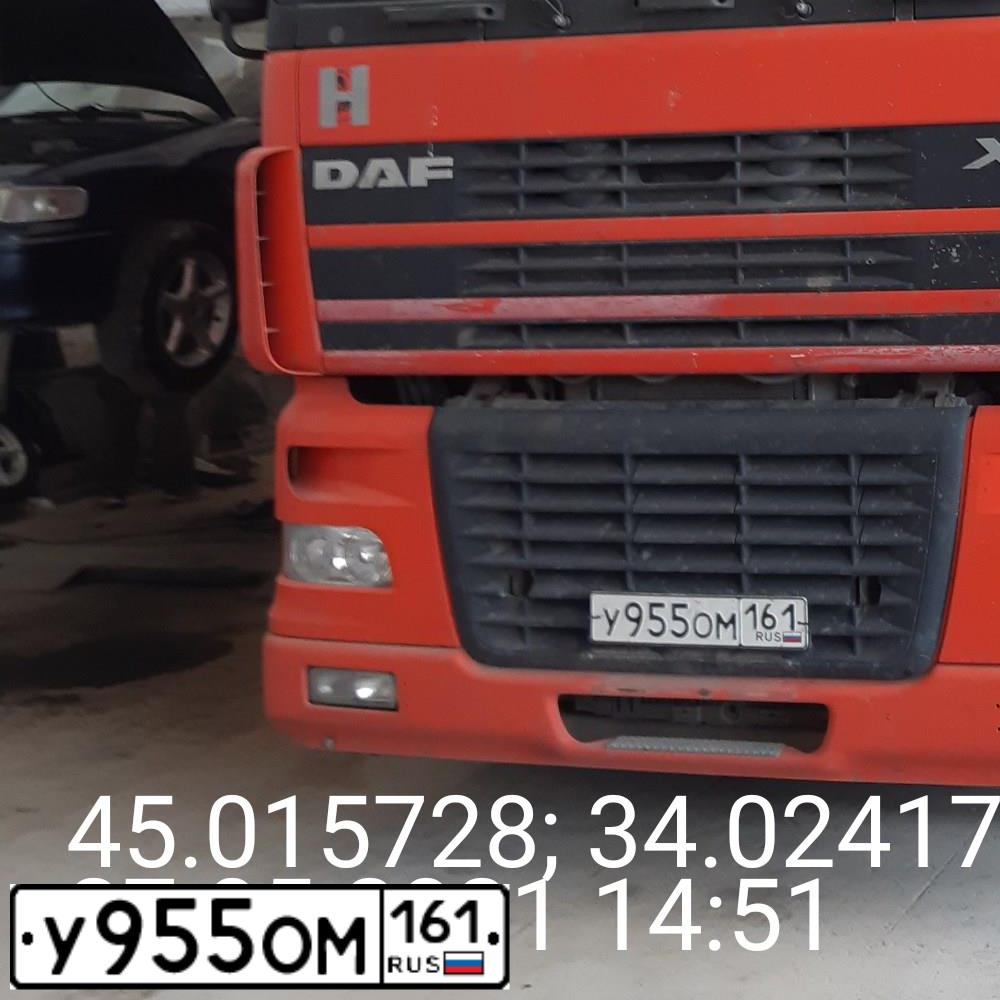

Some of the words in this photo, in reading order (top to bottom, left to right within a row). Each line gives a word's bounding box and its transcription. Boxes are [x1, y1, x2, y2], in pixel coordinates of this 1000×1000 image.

[319, 64, 370, 128] H
[312, 156, 454, 190] DAF
[745, 603, 796, 631] 161
[755, 631, 781, 643] RUS
